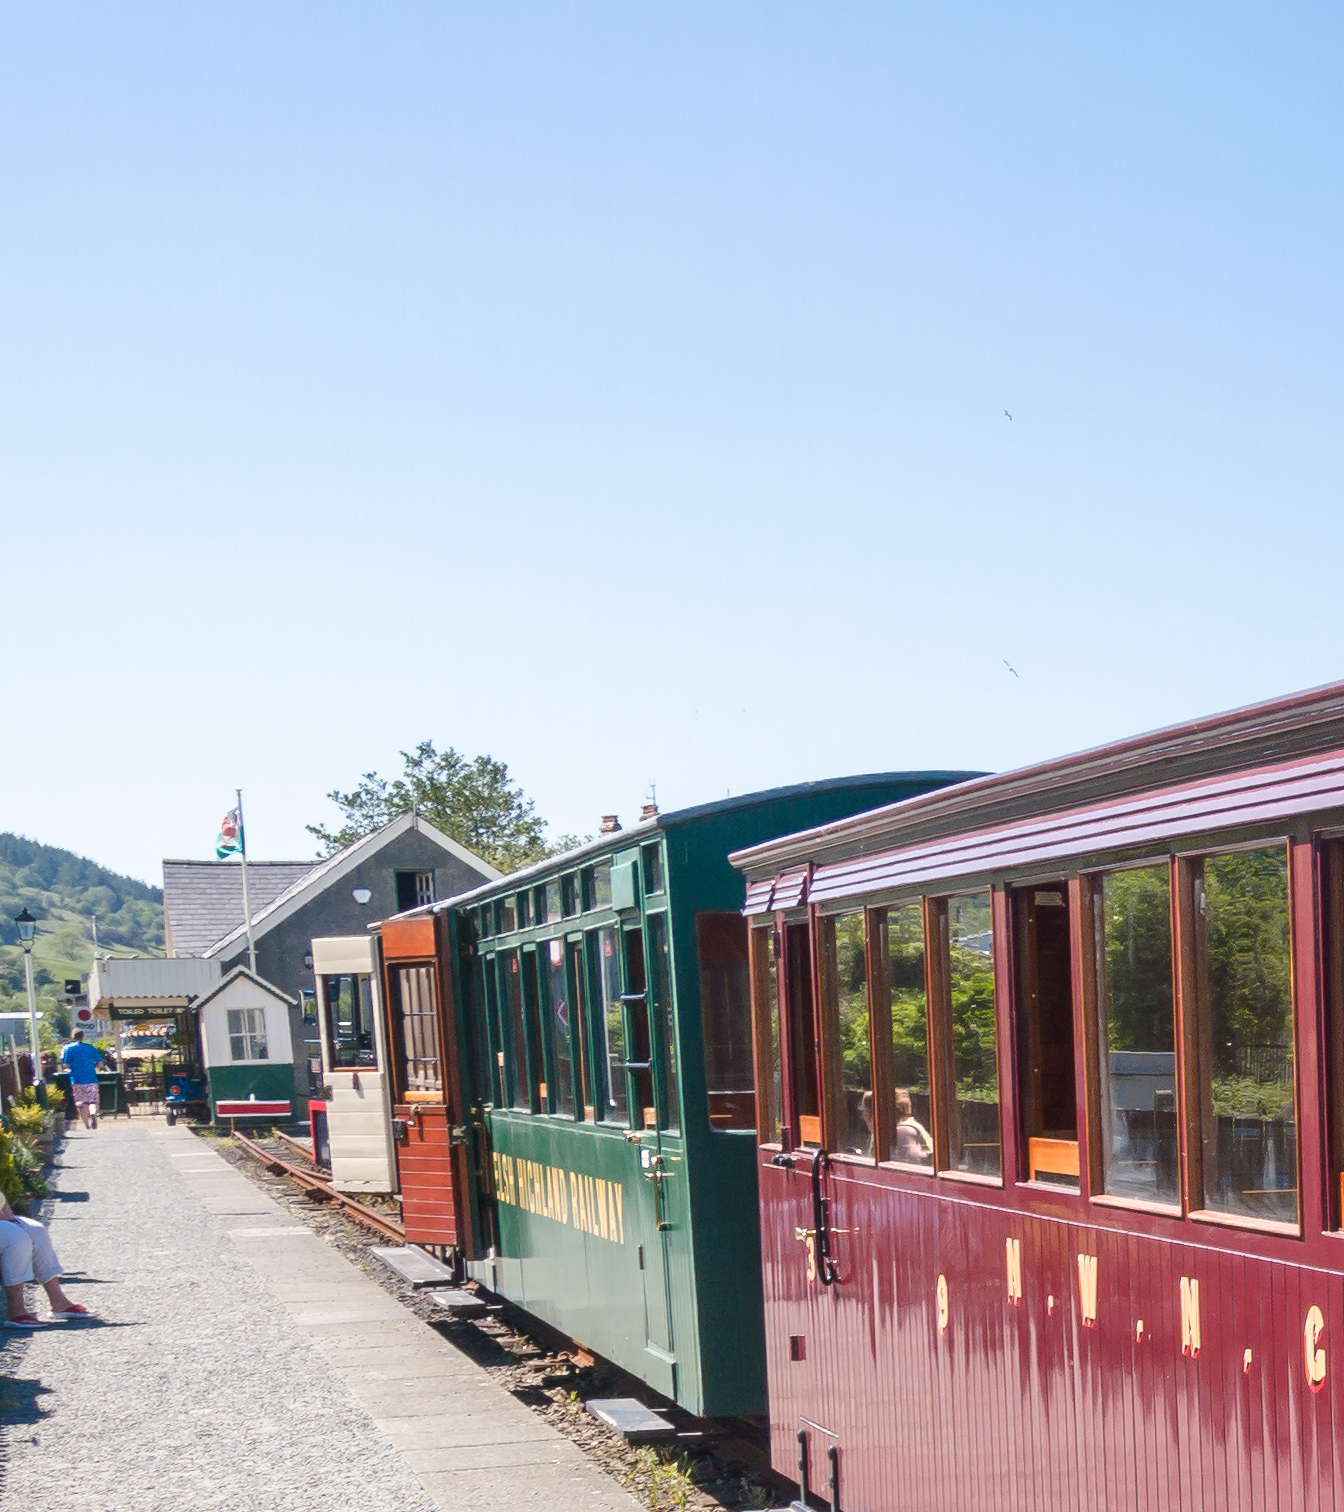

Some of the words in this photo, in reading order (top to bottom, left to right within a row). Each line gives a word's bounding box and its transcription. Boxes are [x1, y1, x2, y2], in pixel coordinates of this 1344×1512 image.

[493, 1152, 516, 1206] ELSH
[516, 1158, 568, 1225] HIGHLAND
[569, 1171, 625, 1245] RAILWAY
[937, 1274, 949, 1336] 9
